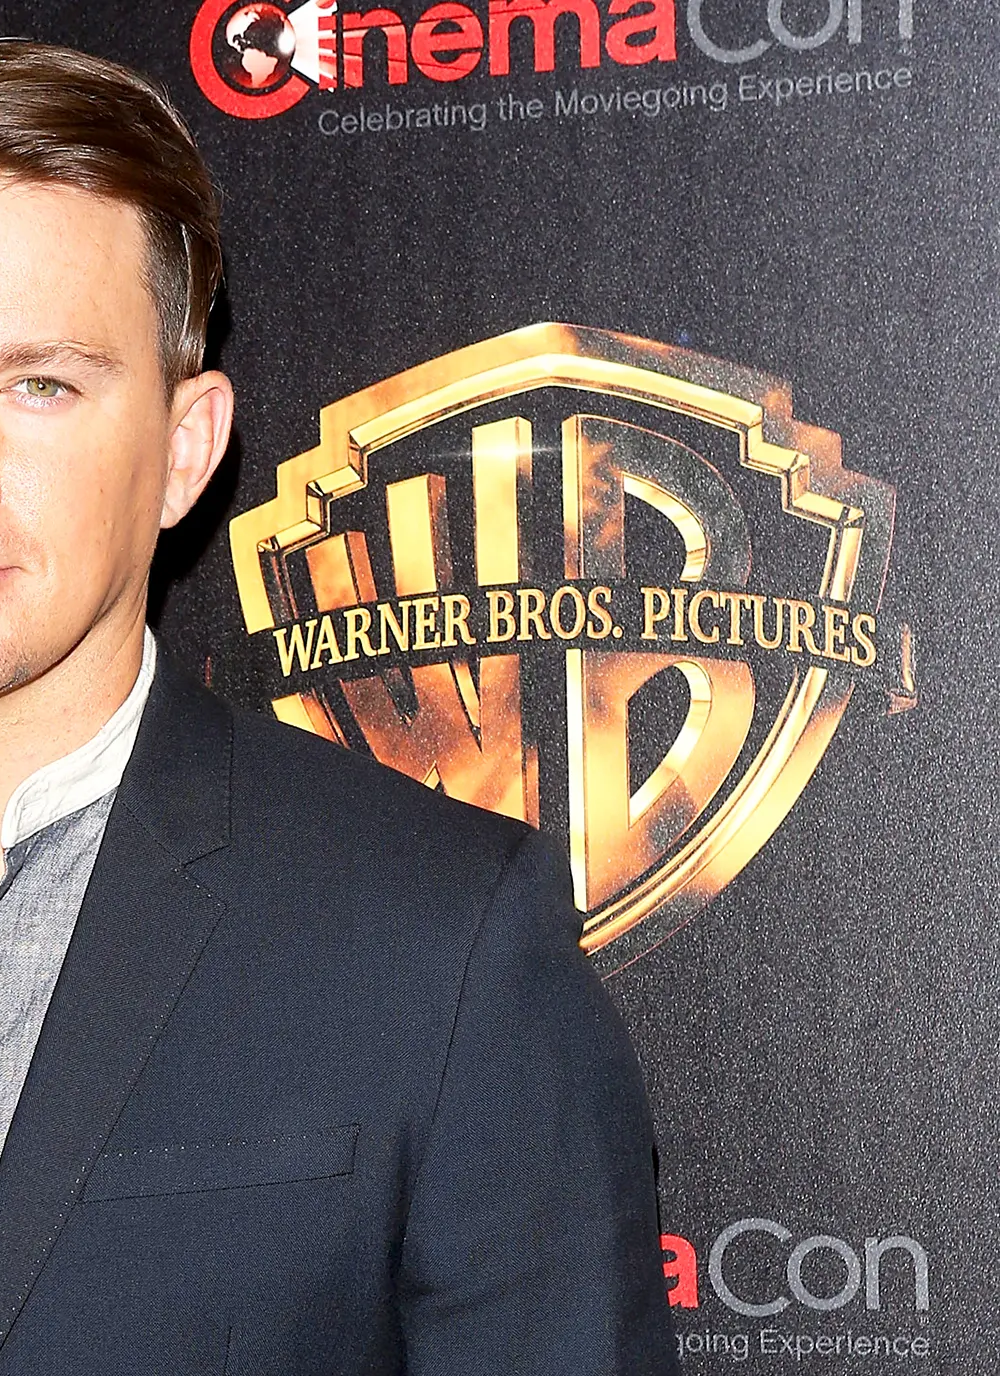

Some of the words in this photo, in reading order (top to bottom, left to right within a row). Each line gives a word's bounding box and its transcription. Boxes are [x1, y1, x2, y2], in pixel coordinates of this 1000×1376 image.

[318, 100, 488, 136] Celebrating
[498, 94, 544, 121] the
[553, 80, 728, 118] Moviegoing
[738, 66, 914, 105] Experience
[273, 594, 476, 678] WARNER
[486, 585, 623, 643] BROS.
[640, 586, 877, 668] PICTURES
[675, 1328, 749, 1361] oing
[760, 1328, 931, 1361] Experience
